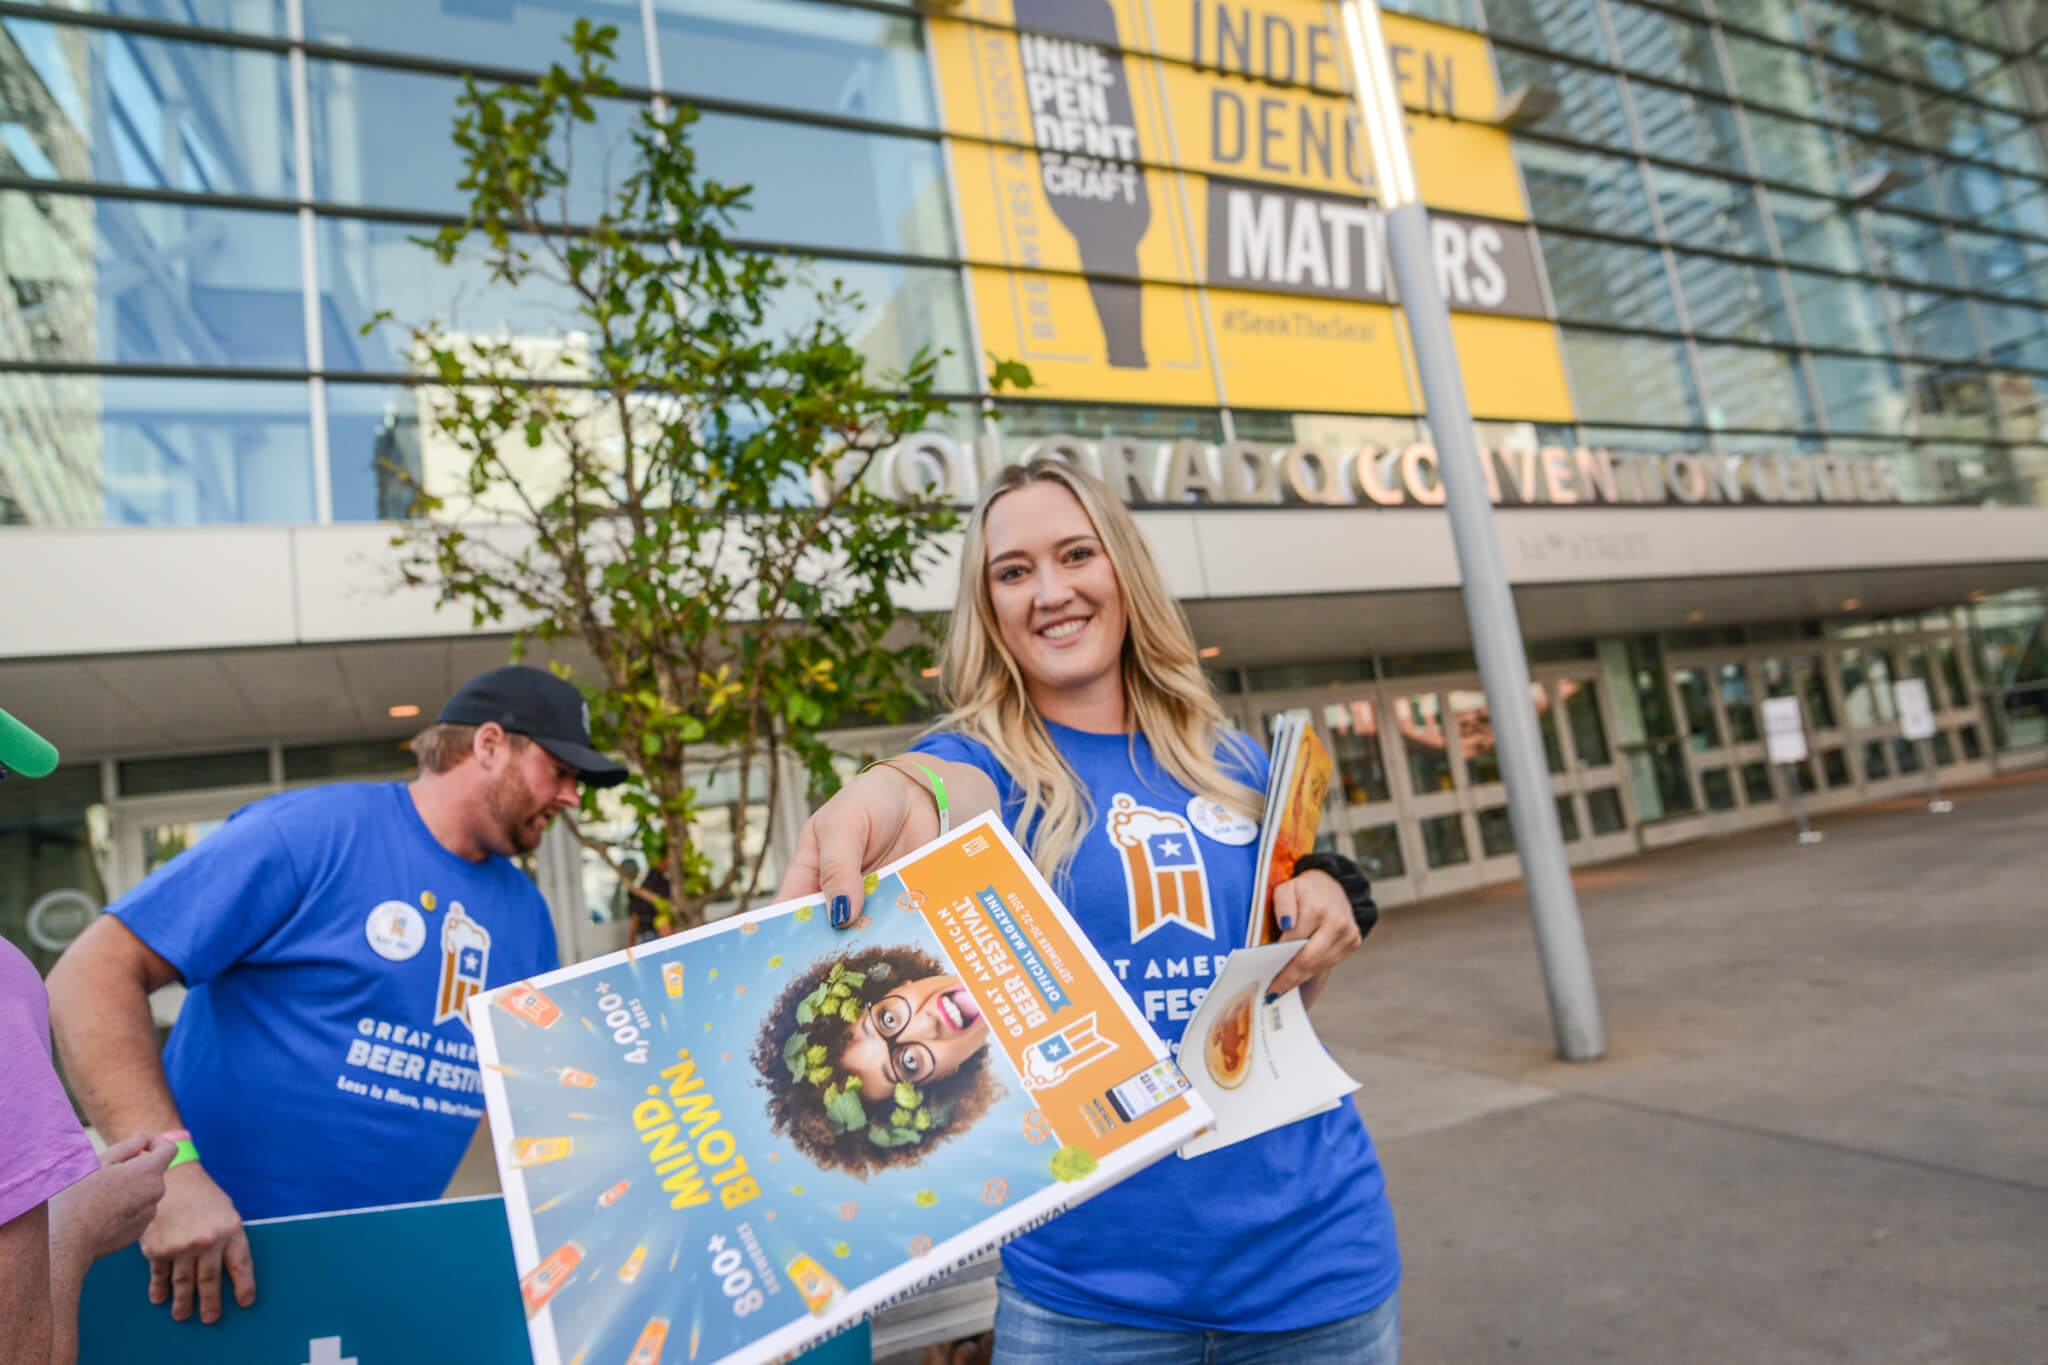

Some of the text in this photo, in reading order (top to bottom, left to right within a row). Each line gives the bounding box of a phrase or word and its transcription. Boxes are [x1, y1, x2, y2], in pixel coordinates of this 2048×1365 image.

[1021, 32, 1115, 85] INDE
[1193, 0, 1455, 115] INDEEN
[1028, 73, 1110, 123] PEN
[1036, 112, 1137, 174] DENT
[1211, 88, 1414, 186] DENC
[1043, 163, 1137, 205] CRAFT
[1227, 190, 1507, 307] MATTRS
[1350, 441, 1742, 505] COVENTION
[937, 907, 992, 984] AMERICAN
[982, 893, 1061, 1003] OFFICIAL MAGAZINE
[1038, 938, 1074, 984] SEPTEMBER
[357, 1017, 431, 1049] GREAT
[595, 981, 651, 1064] 4,000+
[985, 986, 1024, 1038] GREAT
[1003, 971, 1048, 1030] BEER
[346, 1038, 425, 1081] BEER
[632, 1084, 712, 1210] MIND.
[660, 1048, 762, 1211] BLOWN.
[707, 1233, 764, 1318] 800+
[861, 1265, 952, 1321] AMERICAN
[957, 1240, 996, 1270] BEER
[1000, 1201, 1071, 1247] FESTIVAL
